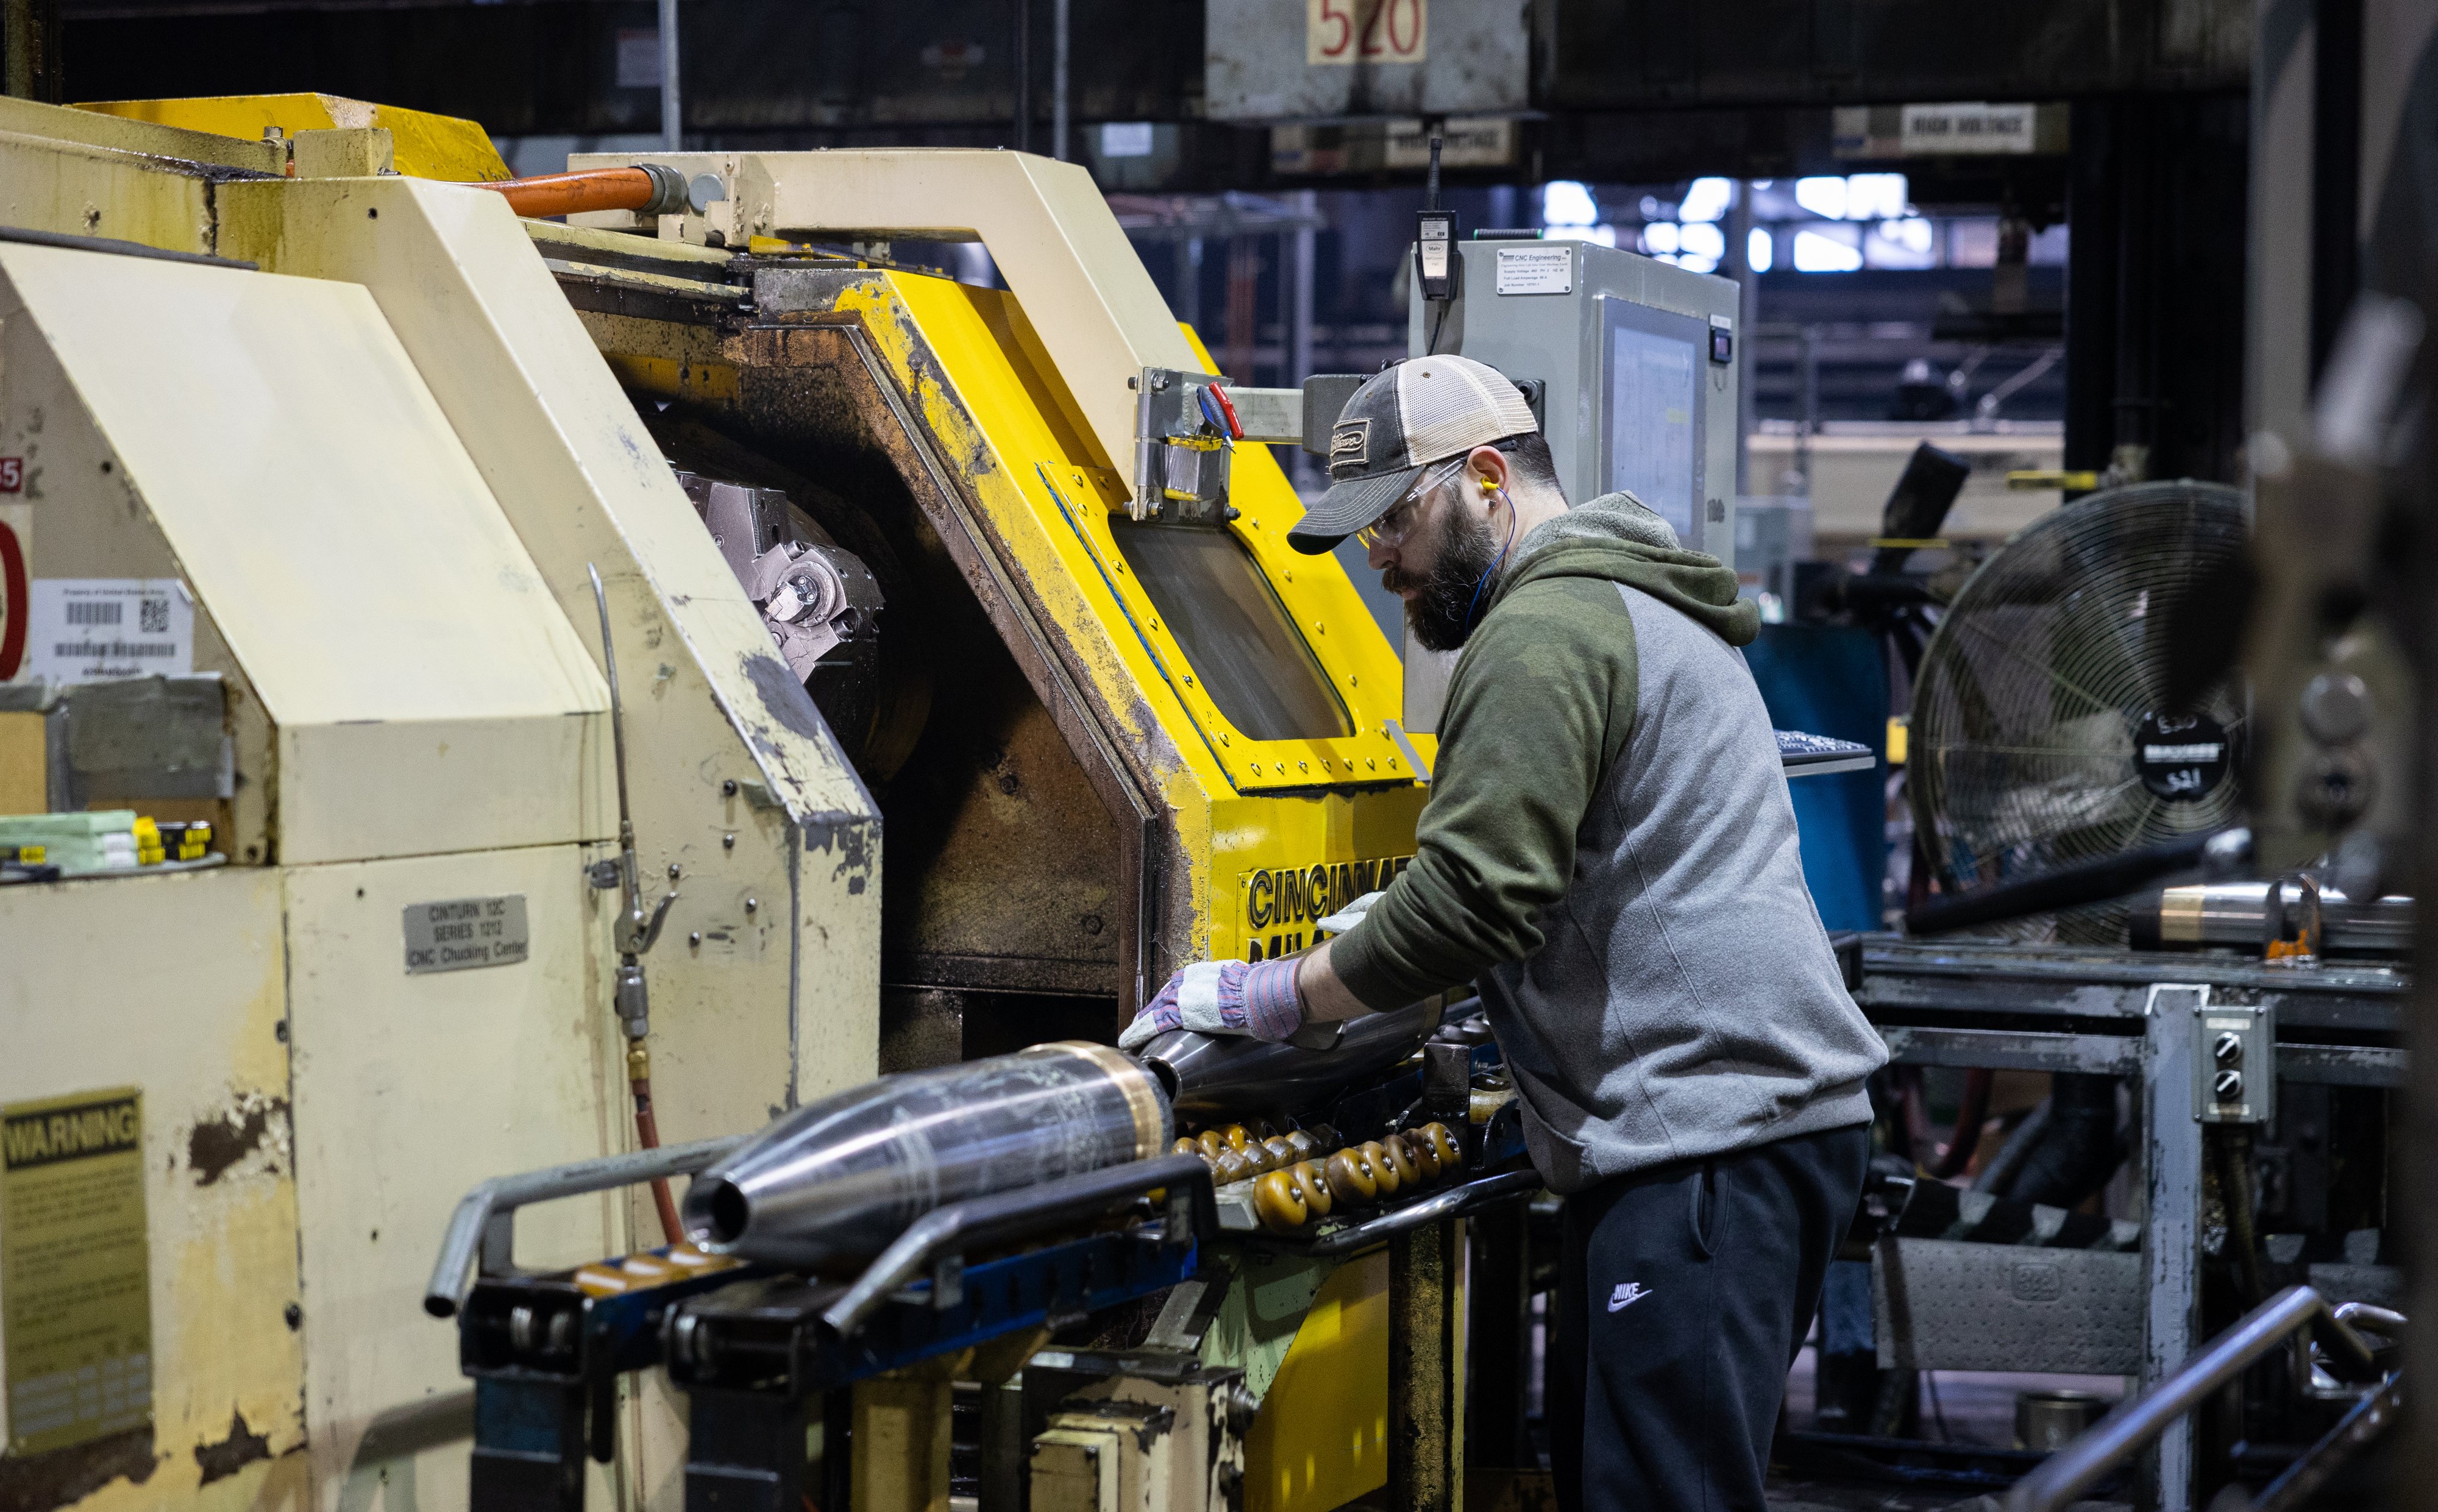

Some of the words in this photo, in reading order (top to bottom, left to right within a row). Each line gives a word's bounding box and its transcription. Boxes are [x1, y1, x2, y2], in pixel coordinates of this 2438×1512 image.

[1320, 0, 1420, 57] 520
[0, 461, 19, 487] 5
[1248, 854, 1418, 930] CINCINNA
[428, 903, 480, 922] CINTURN
[433, 923, 473, 942] SERIES
[408, 948, 436, 966] CNC
[440, 945, 489, 963] Chucking
[493, 941, 527, 957] Center
[4, 1104, 136, 1163] WARNING
[1614, 1282, 1640, 1301] NIKE
